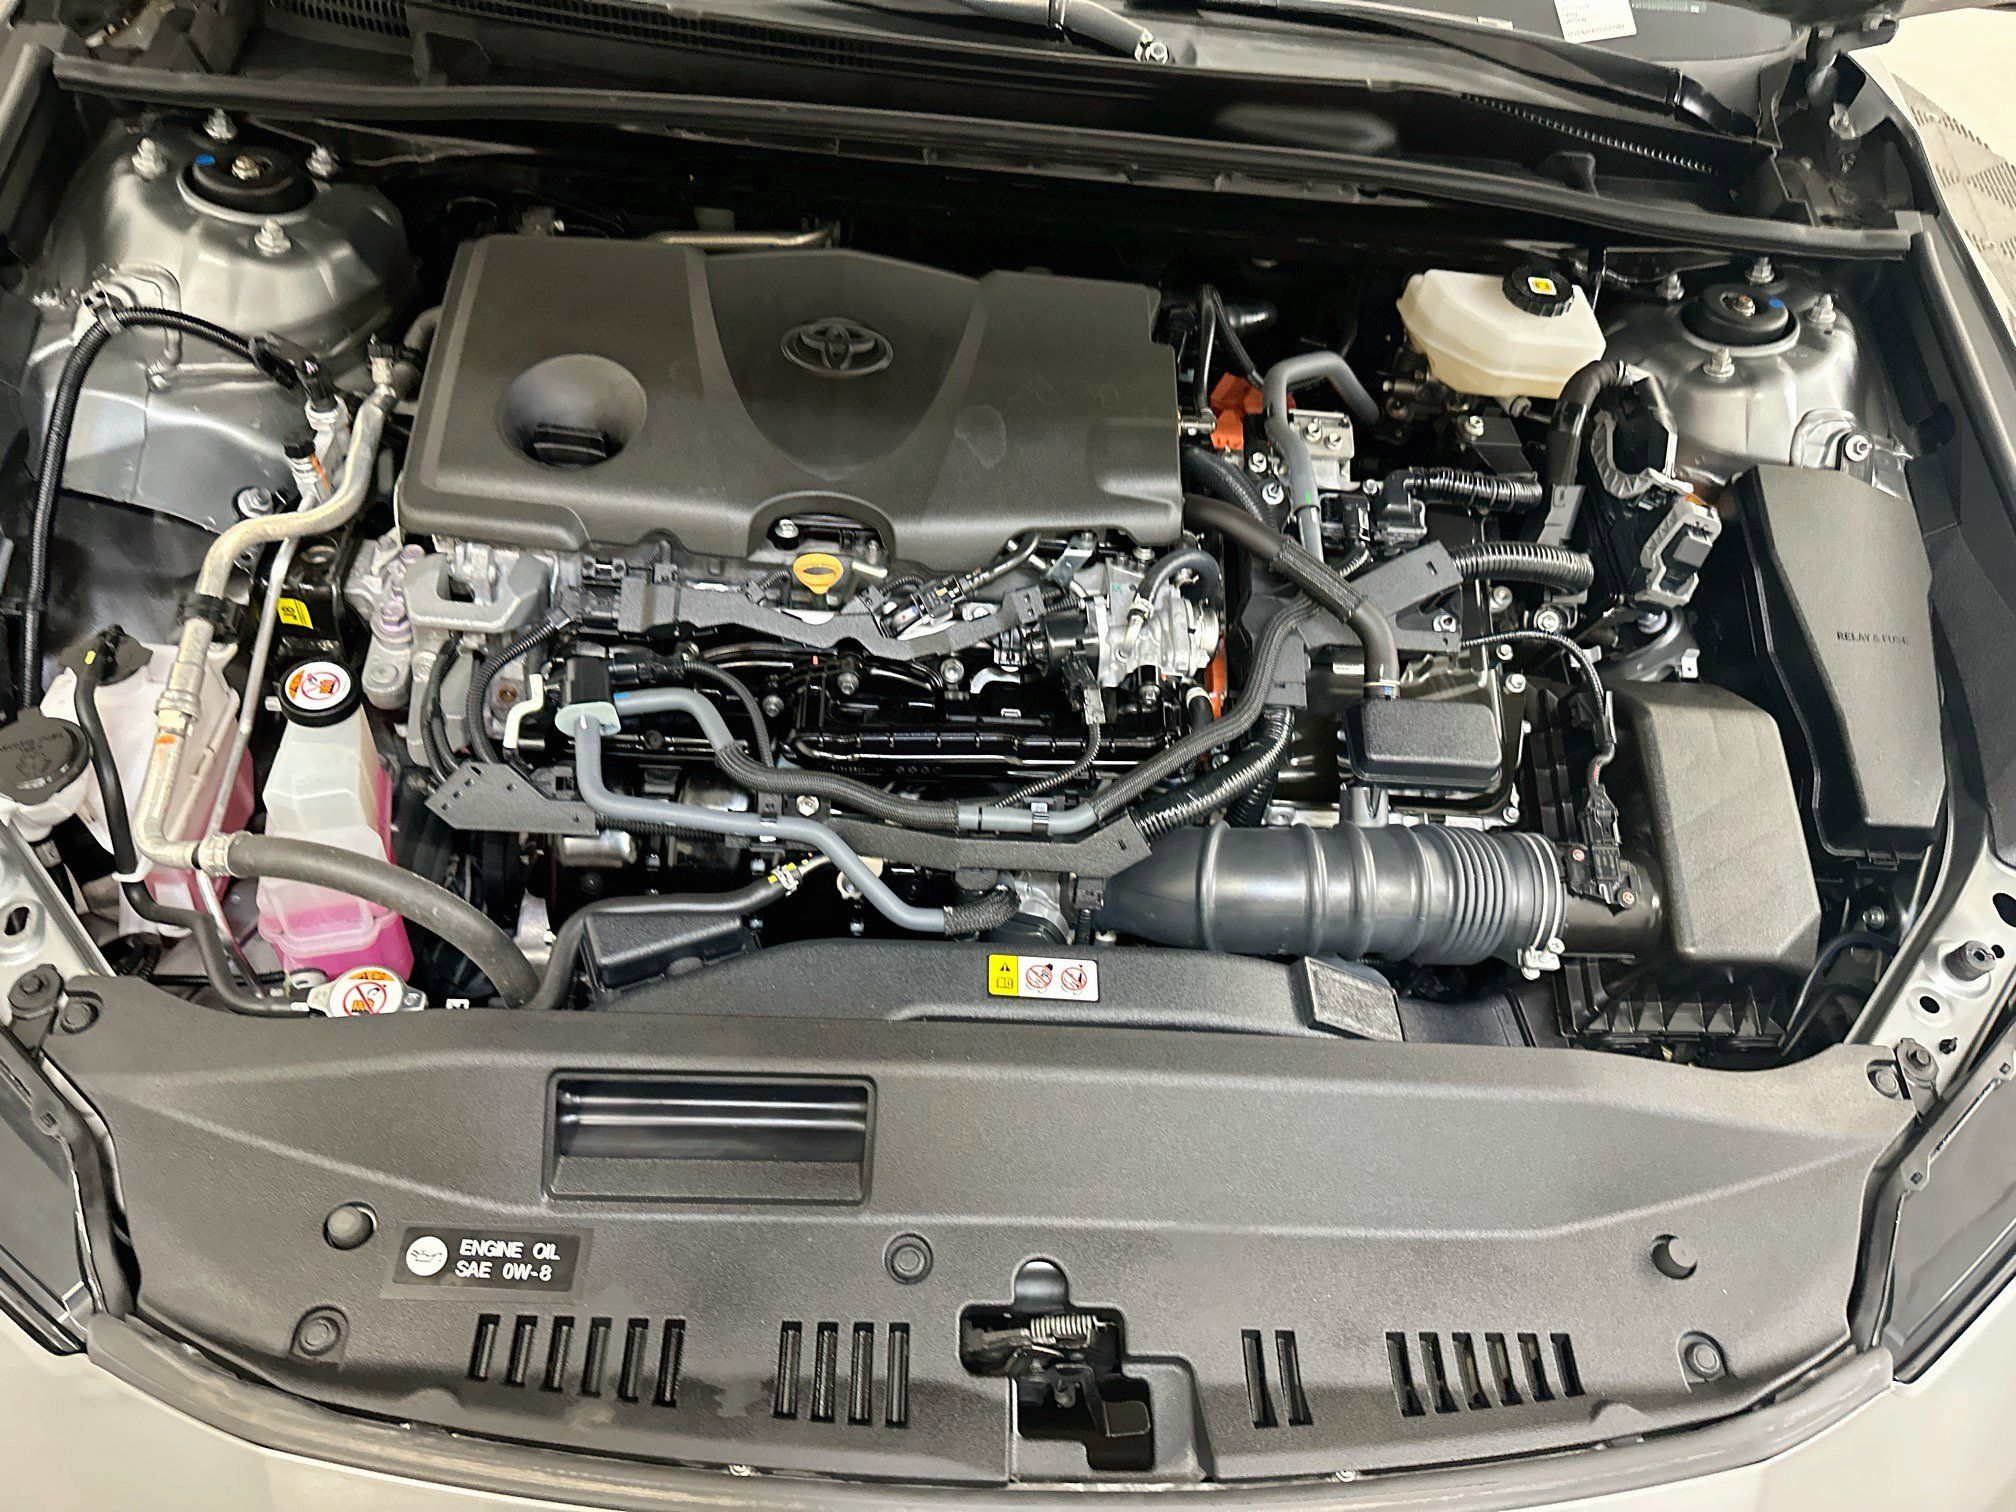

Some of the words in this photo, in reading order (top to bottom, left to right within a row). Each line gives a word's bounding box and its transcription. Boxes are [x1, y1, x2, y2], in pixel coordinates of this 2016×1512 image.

[1836, 630, 1870, 642] RELAY
[1881, 634, 1910, 646] FUSE
[459, 1239, 525, 1259] ENGINE
[532, 1242, 561, 1261] OIL
[454, 1260, 493, 1279] SAE
[502, 1262, 553, 1282] 0W-8
